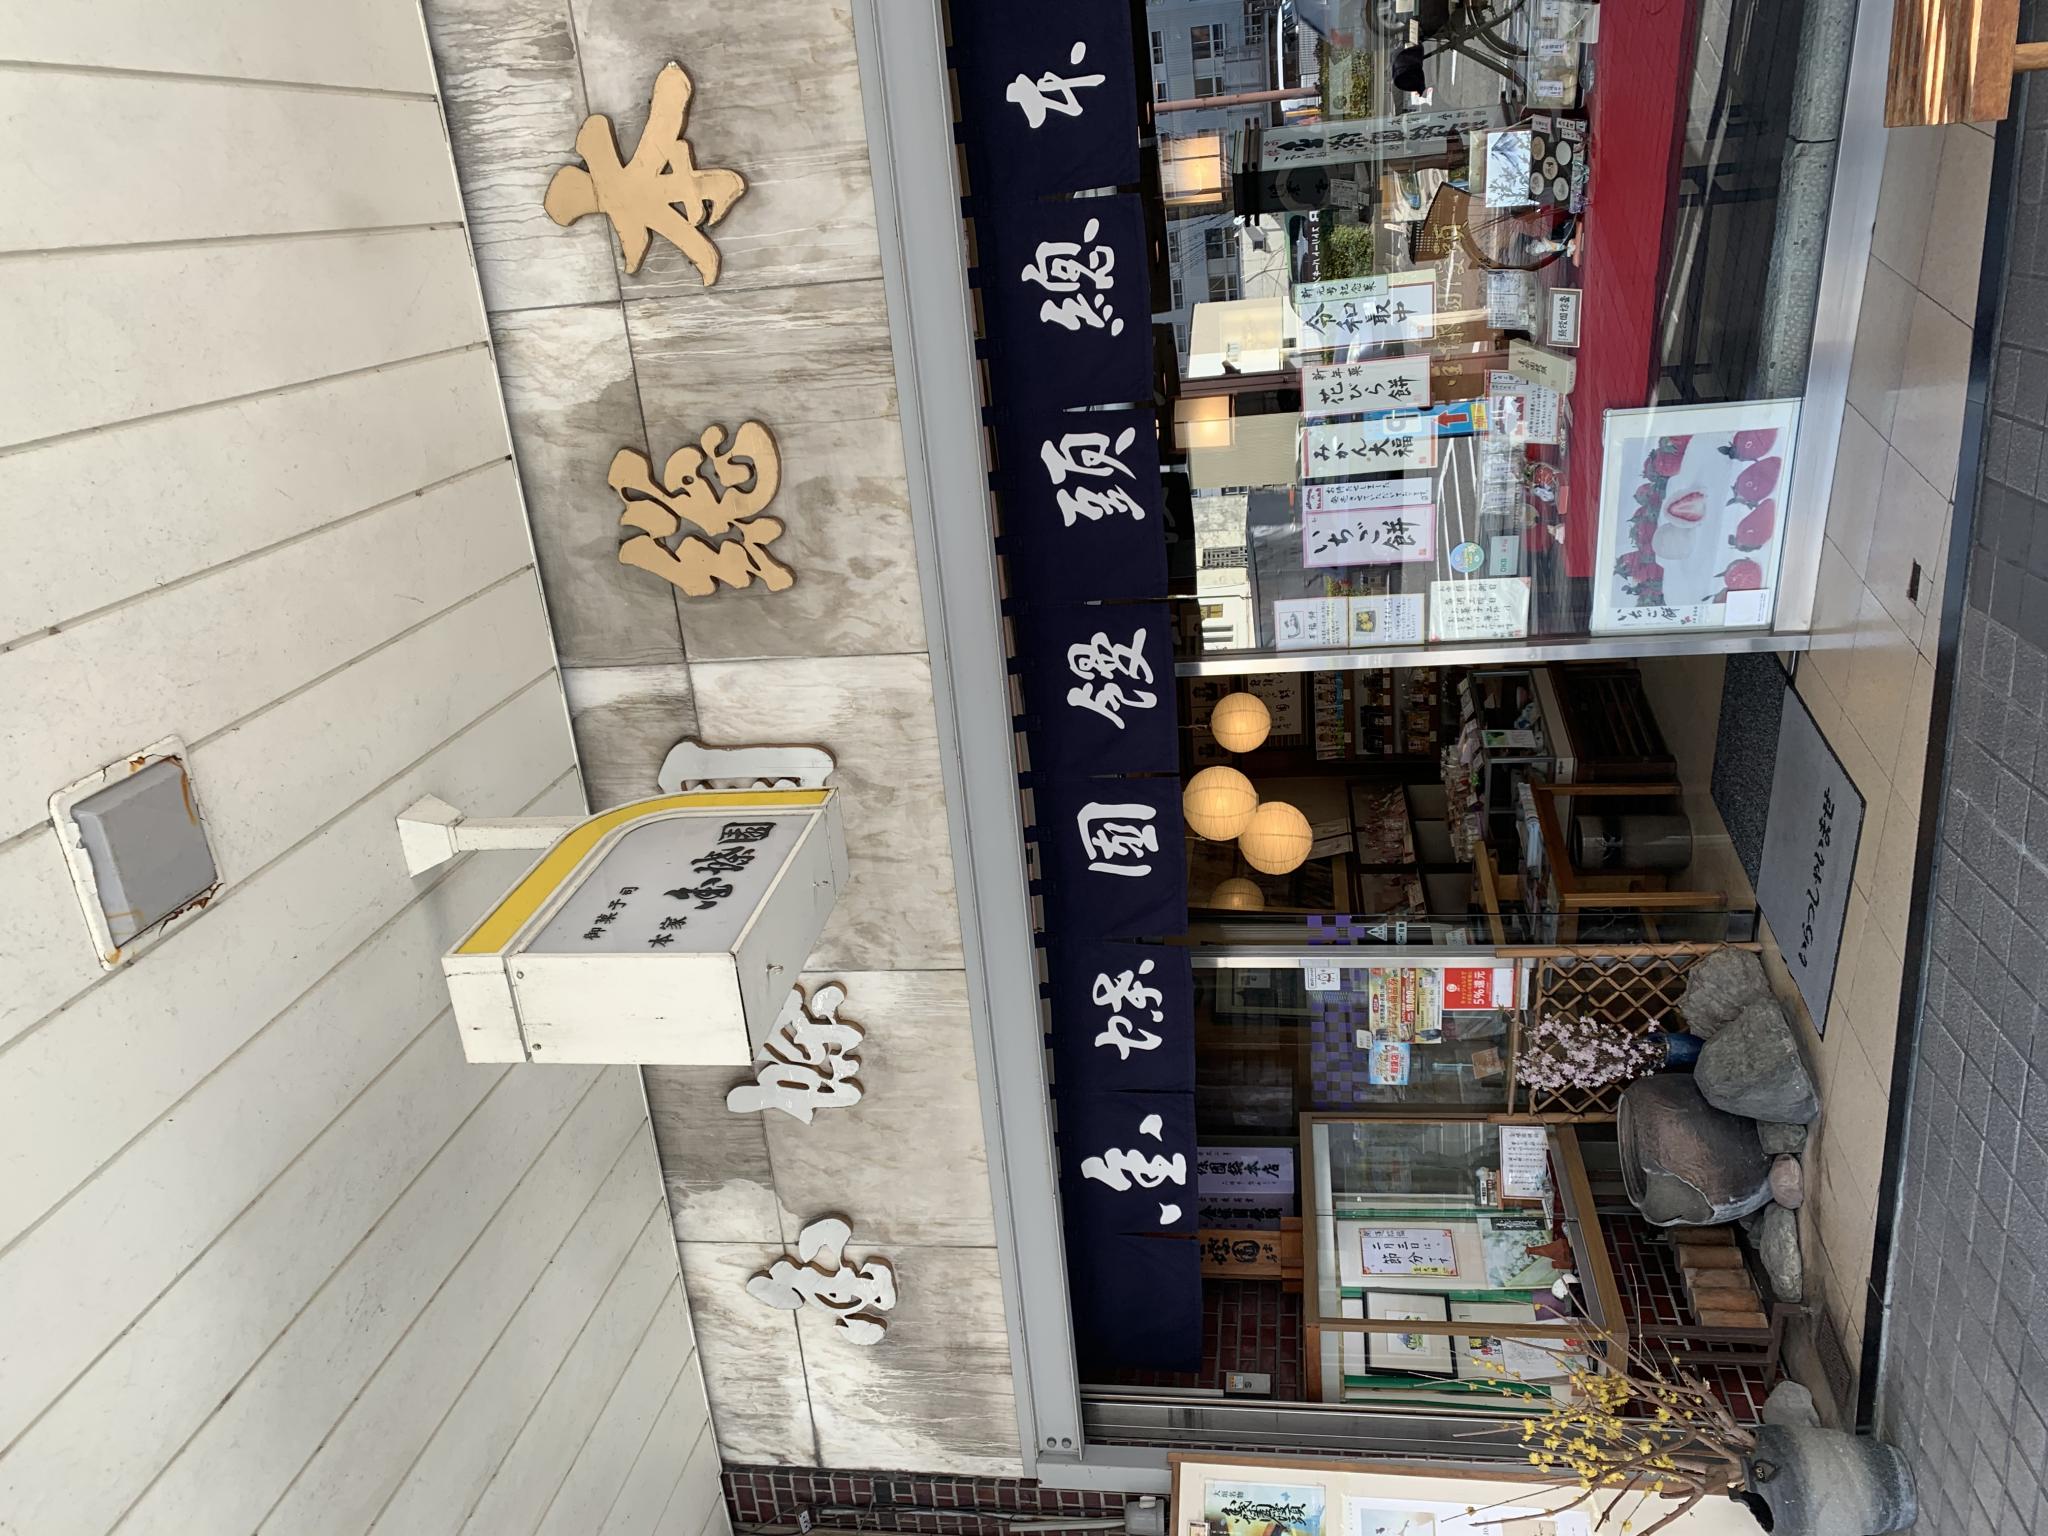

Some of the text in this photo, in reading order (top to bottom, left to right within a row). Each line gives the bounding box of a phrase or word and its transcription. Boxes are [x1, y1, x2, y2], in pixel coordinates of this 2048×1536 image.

[1300, 281, 1376, 299] 新元号記念菓
[1304, 299, 1418, 336] 令和最中
[1319, 375, 1421, 405] 花びら餅
[1312, 435, 1415, 463] みかん大福
[1311, 517, 1420, 554] いちご餅
[1616, 607, 1681, 621] いちご餅
[583, 885, 639, 940] 御菓子司
[648, 915, 687, 948] 本家
[1473, 971, 1485, 1005] 5%還元
